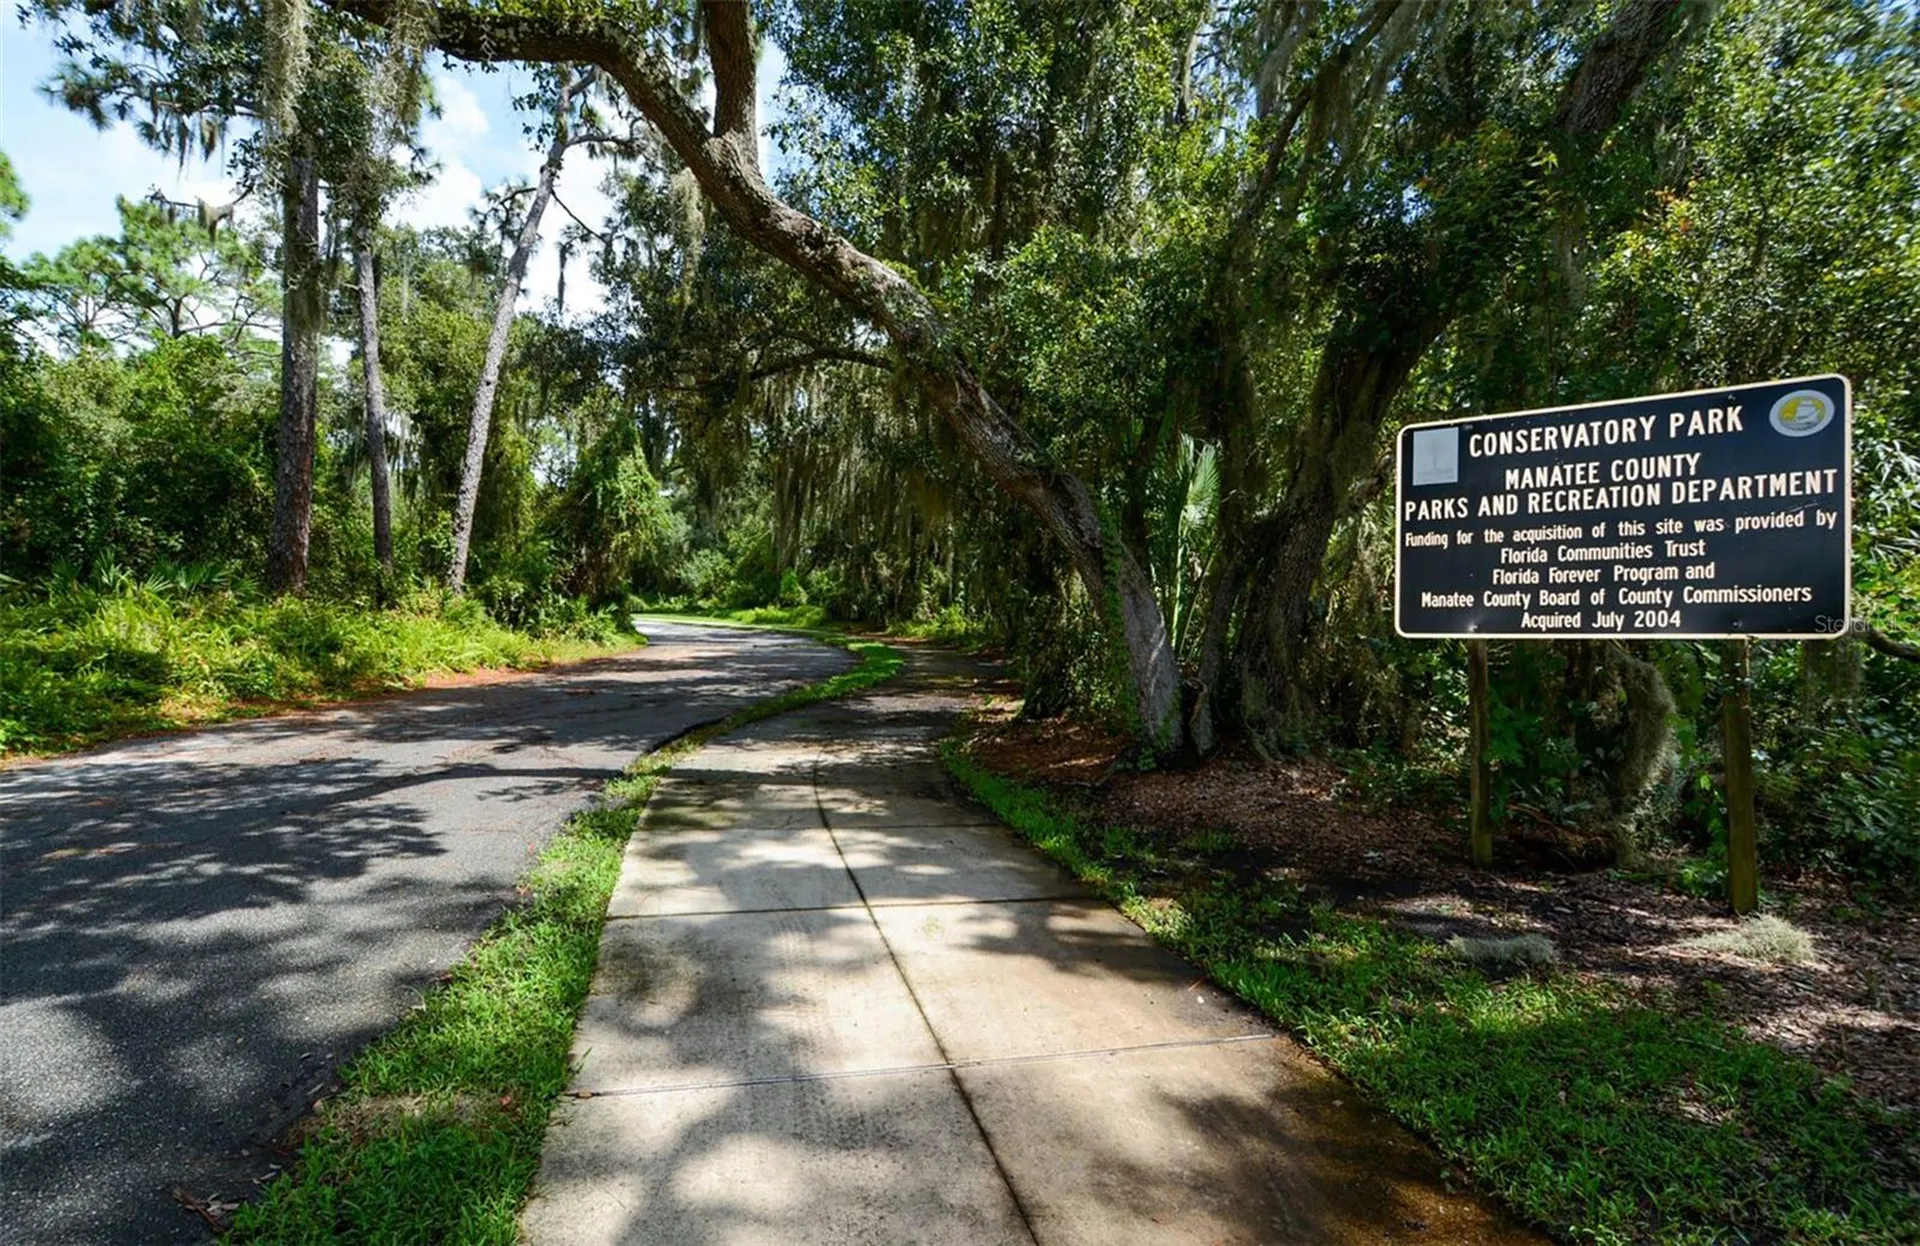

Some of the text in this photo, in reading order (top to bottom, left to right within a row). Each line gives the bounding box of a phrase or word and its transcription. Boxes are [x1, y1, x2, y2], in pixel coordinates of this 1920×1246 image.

[1469, 405, 1744, 458] CONSERVATORY PARK
[1505, 452, 1701, 490] MANATEE COUNTY
[1404, 468, 1838, 522] PARKS AND RECREATION DEPARTMENT
[1405, 508, 1837, 549] Funding for the acquisition of this site was provided by
[1501, 539, 1706, 564] Florida Communities Trust
[1492, 562, 1716, 586] Florida Forever Program and
[1421, 585, 1812, 613] Manatee County Board of County Commissioners
[1521, 610, 1682, 632] Acquired July 2004
